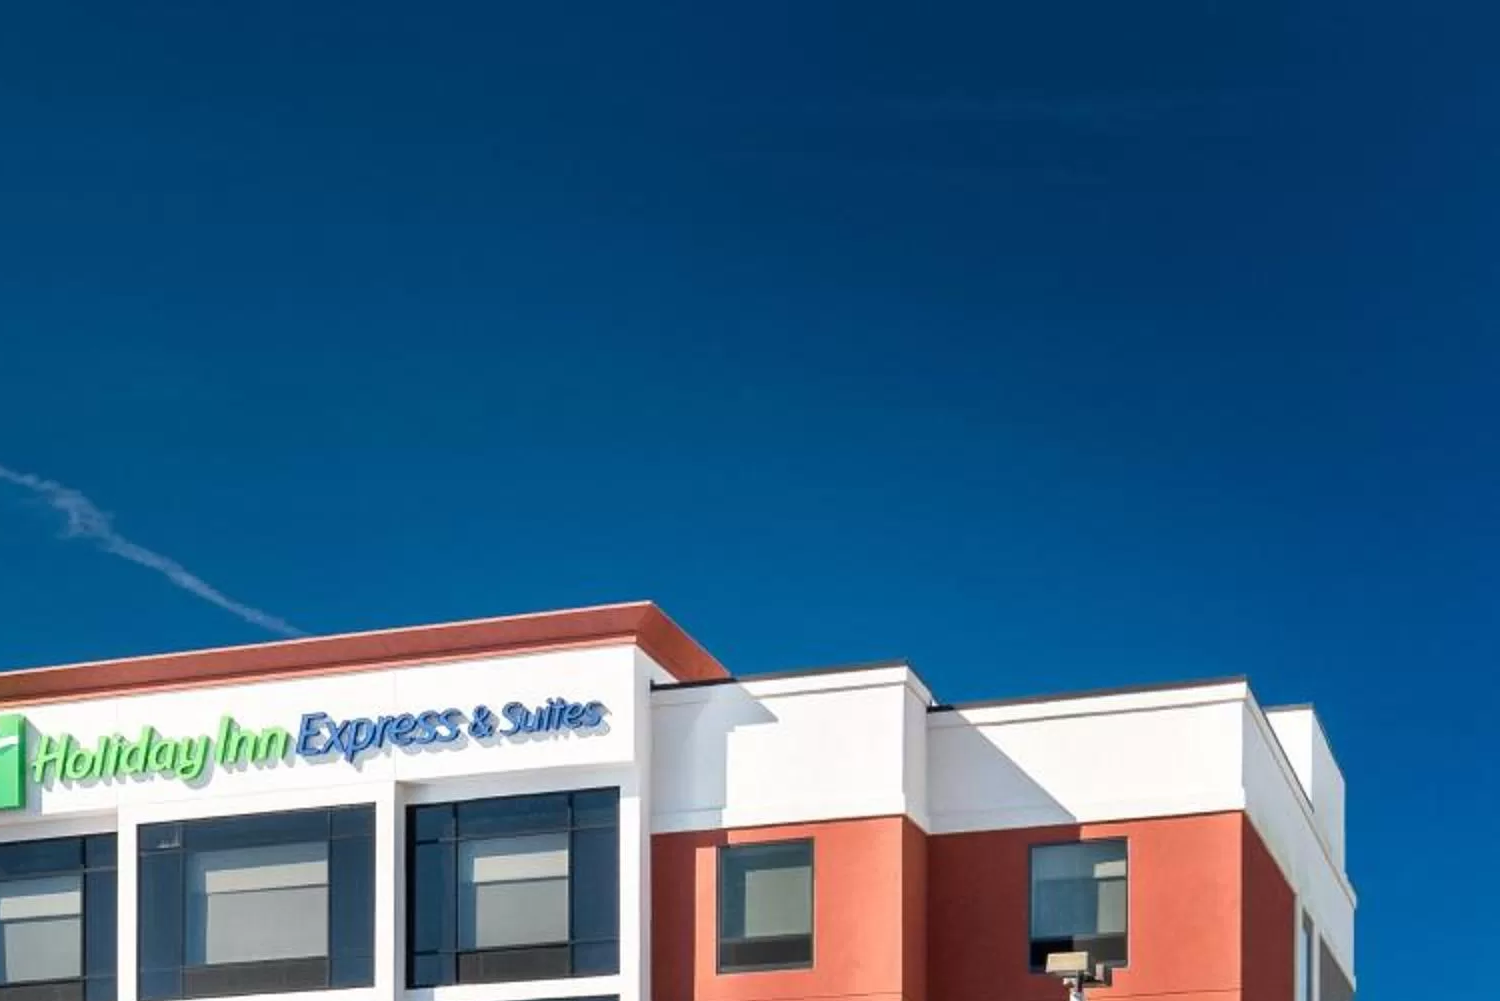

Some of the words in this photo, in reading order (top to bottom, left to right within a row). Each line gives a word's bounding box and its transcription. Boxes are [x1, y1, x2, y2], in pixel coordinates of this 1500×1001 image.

[33, 726, 210, 783] Holiday
[215, 714, 291, 765] Inn
[296, 712, 463, 763] Express
[468, 705, 493, 738] &
[500, 697, 604, 736] Suites
